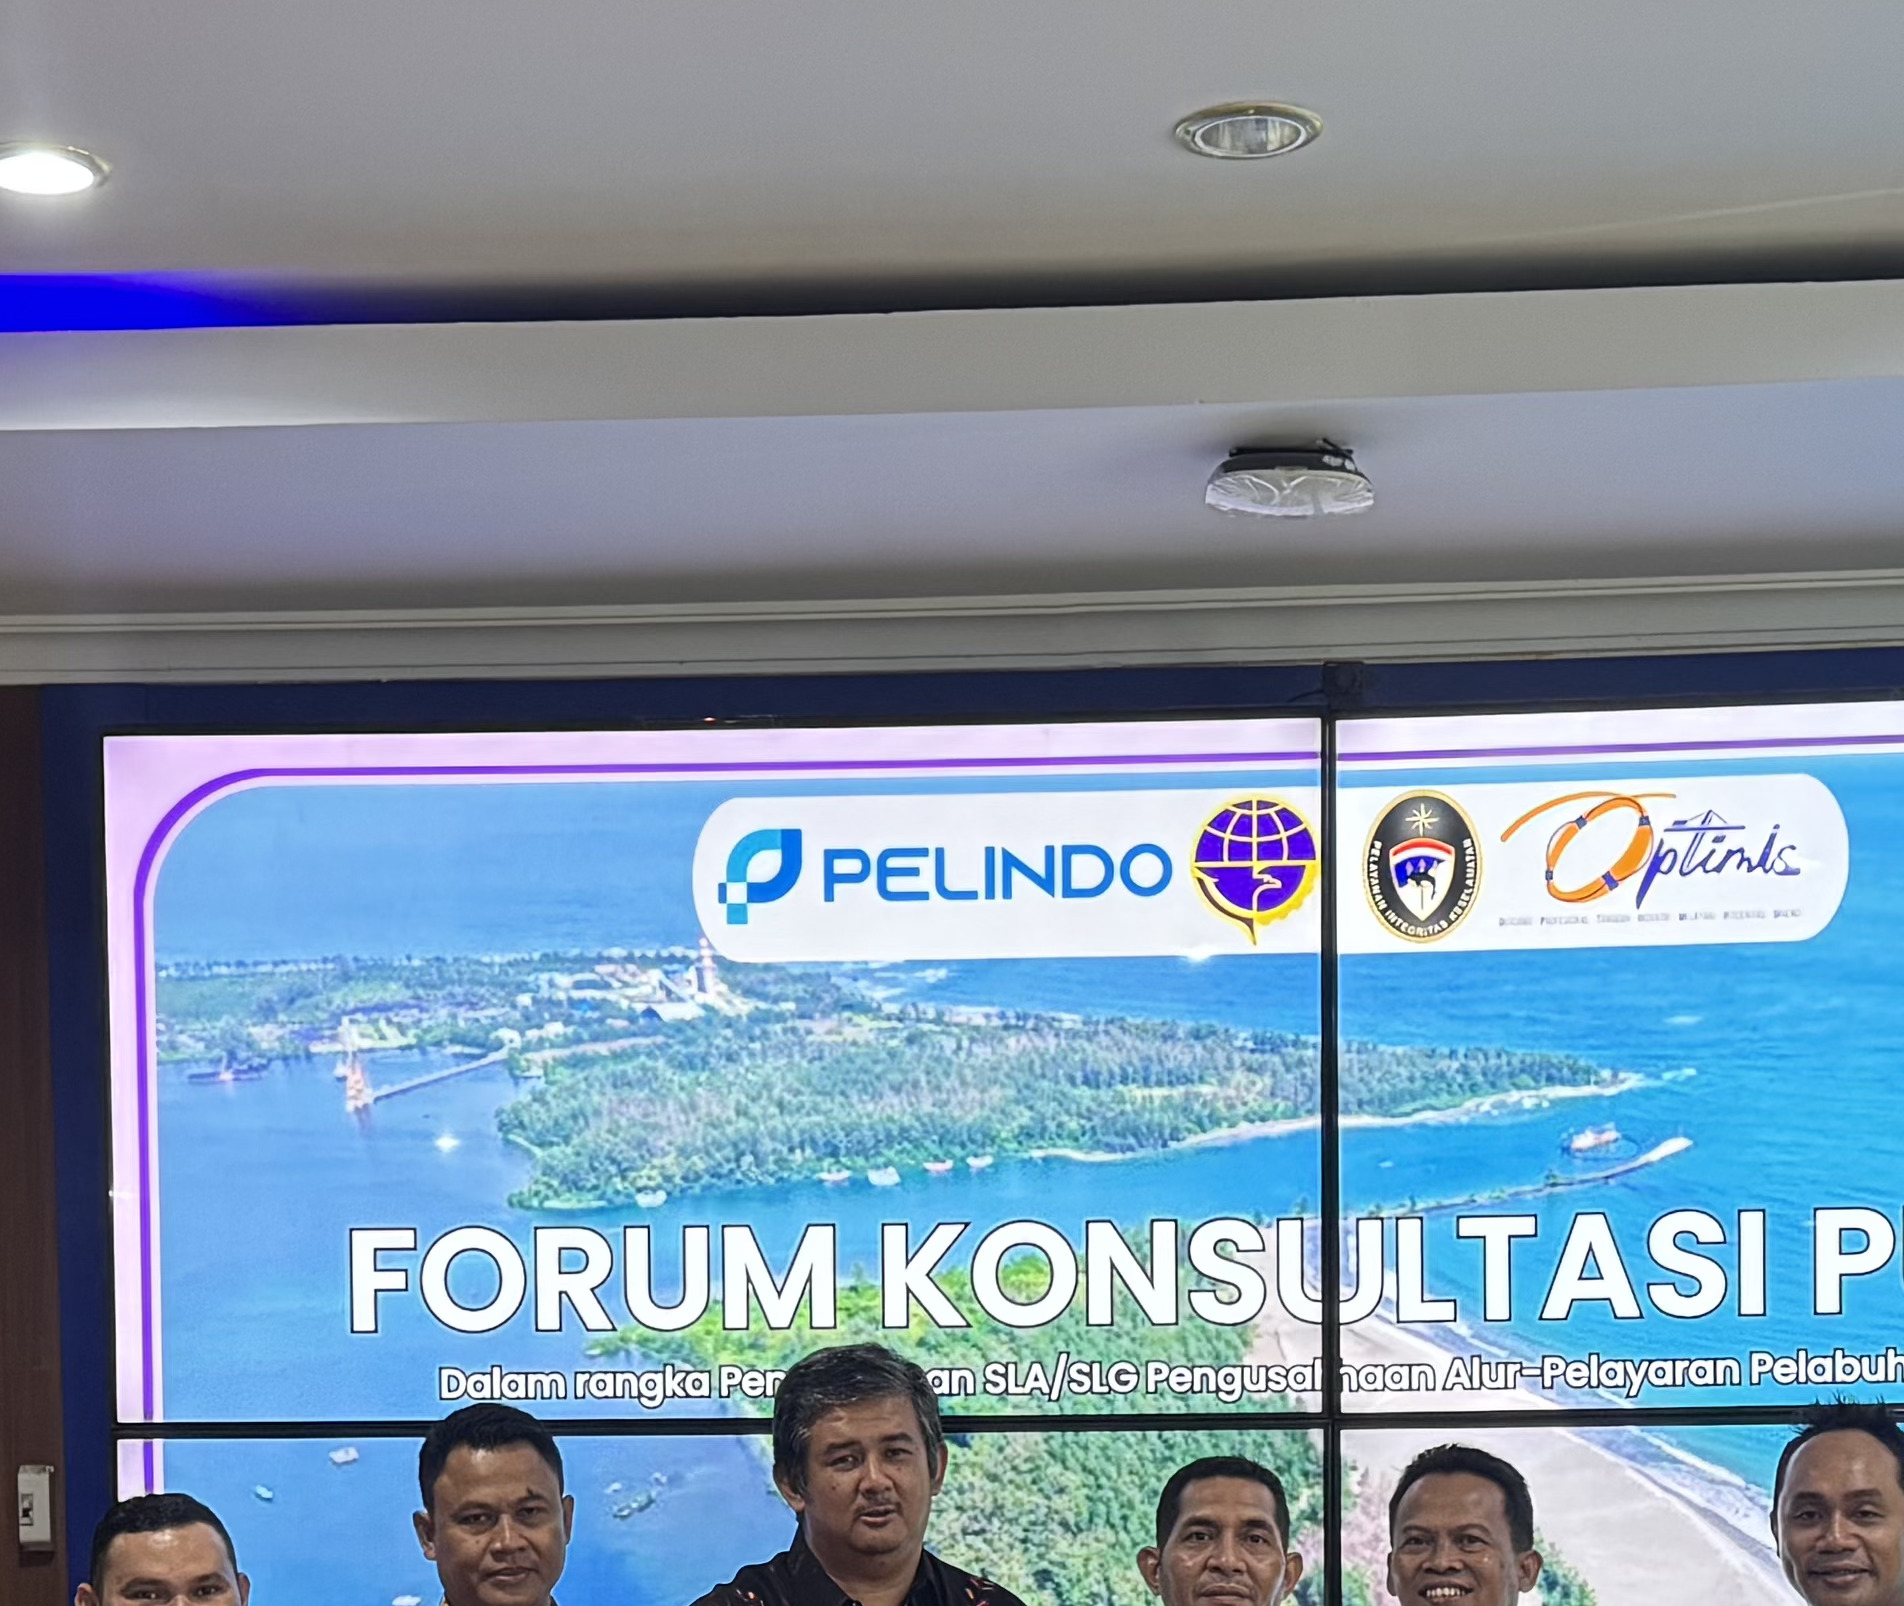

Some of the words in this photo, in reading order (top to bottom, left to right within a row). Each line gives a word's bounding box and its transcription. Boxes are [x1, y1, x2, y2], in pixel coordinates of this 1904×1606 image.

[823, 843, 1173, 902] PELINDO
[347, 1221, 838, 1335] FORUM
[881, 1206, 1769, 1331] KONSULTASI
[439, 1365, 567, 1401] Dalam
[574, 1363, 712, 1409] rangka
[984, 1352, 1138, 1403] SLA/SLG
[1442, 1351, 1738, 1397] Alur-Pelayaran
